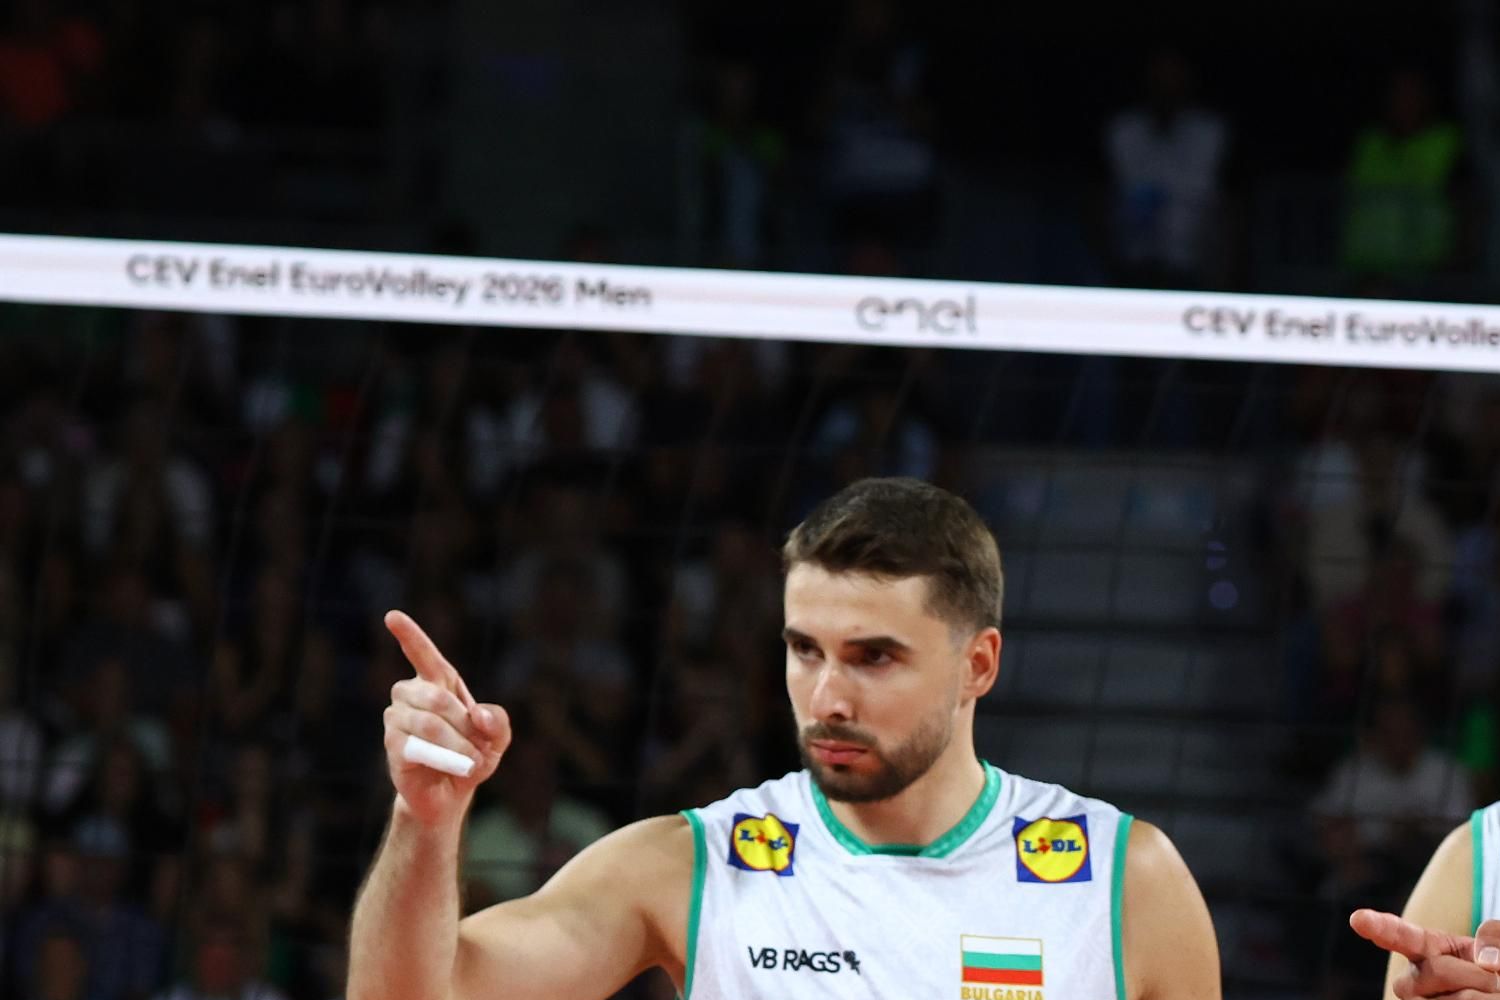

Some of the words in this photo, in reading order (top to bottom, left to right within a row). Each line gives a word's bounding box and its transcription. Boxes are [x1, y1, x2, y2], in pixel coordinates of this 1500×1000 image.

[126, 254, 198, 285] CEV
[208, 256, 280, 288] Enel
[290, 260, 470, 305] EuroVolley
[483, 272, 563, 301] 2026
[575, 276, 653, 305] Men
[855, 291, 977, 335] enel
[1182, 305, 1255, 335] CEV
[1264, 308, 1336, 338] Enel
[748, 946, 777, 969] VB
[782, 949, 841, 973] RAGS
